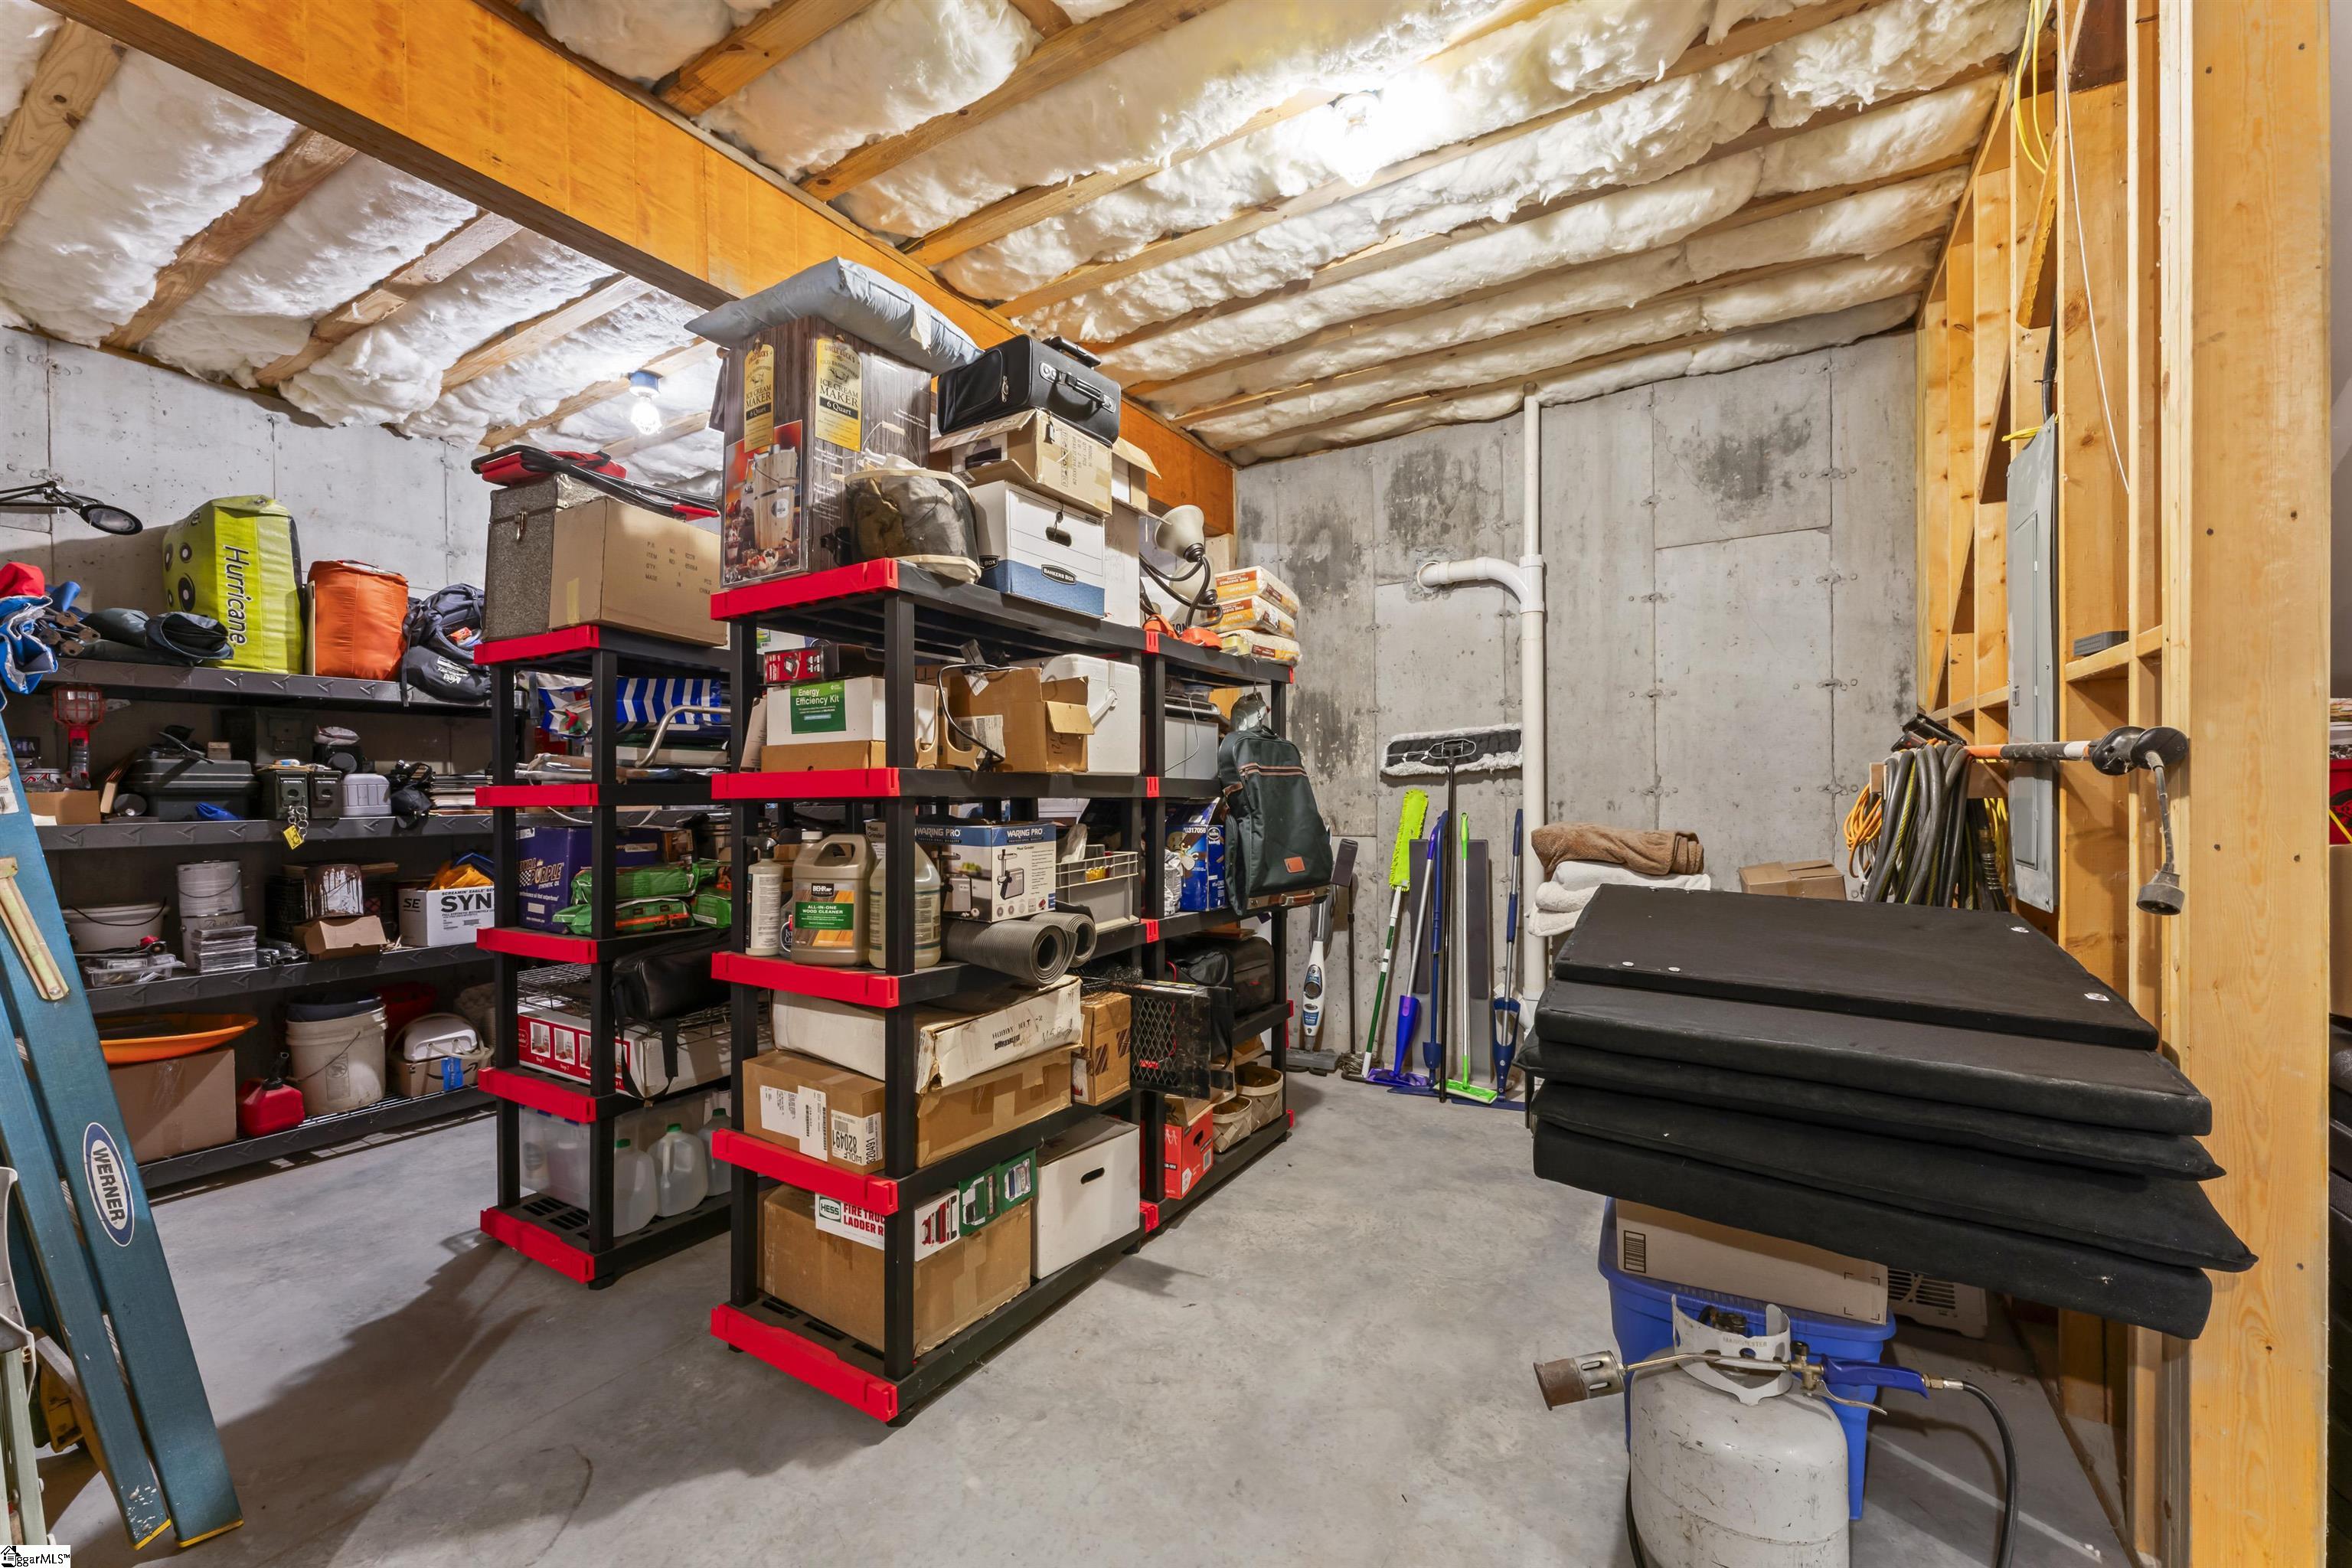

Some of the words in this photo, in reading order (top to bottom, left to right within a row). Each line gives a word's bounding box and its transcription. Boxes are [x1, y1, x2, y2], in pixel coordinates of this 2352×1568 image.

[753, 384, 772, 395] CREAM
[819, 384, 858, 407] MAKER
[820, 377, 833, 389] ICE
[834, 381, 858, 398] CREAM
[746, 391, 771, 409] MAKER
[753, 407, 766, 416] Quart
[832, 401, 851, 416] Quart
[645, 573, 658, 582] MADE
[1044, 567, 1064, 580] BANKERS
[1064, 573, 1074, 582] BOX
[224, 544, 252, 645] Hurricane
[795, 697, 828, 706] Efficiency
[830, 694, 839, 703] Kit
[799, 688, 819, 697] Energy
[916, 827, 944, 838] WARING
[946, 828, 961, 837] PRO
[1007, 828, 1030, 838] WARING
[530, 862, 564, 886] PURPLE
[403, 898, 420, 909] SE
[440, 893, 492, 913] SYN
[992, 1026, 1014, 1039] HOBBY
[1018, 1019, 1031, 1030] KIT
[832, 1129, 858, 1154] 820491
[844, 1152, 862, 1164] WOLF
[866, 1138, 876, 1165] 820491
[93, 1147, 125, 1222] WERNER
[821, 1203, 839, 1216] HESS
[844, 1203, 862, 1217] FIRE
[862, 1209, 885, 1224] TRUC
[844, 1215, 876, 1234] LADDER
